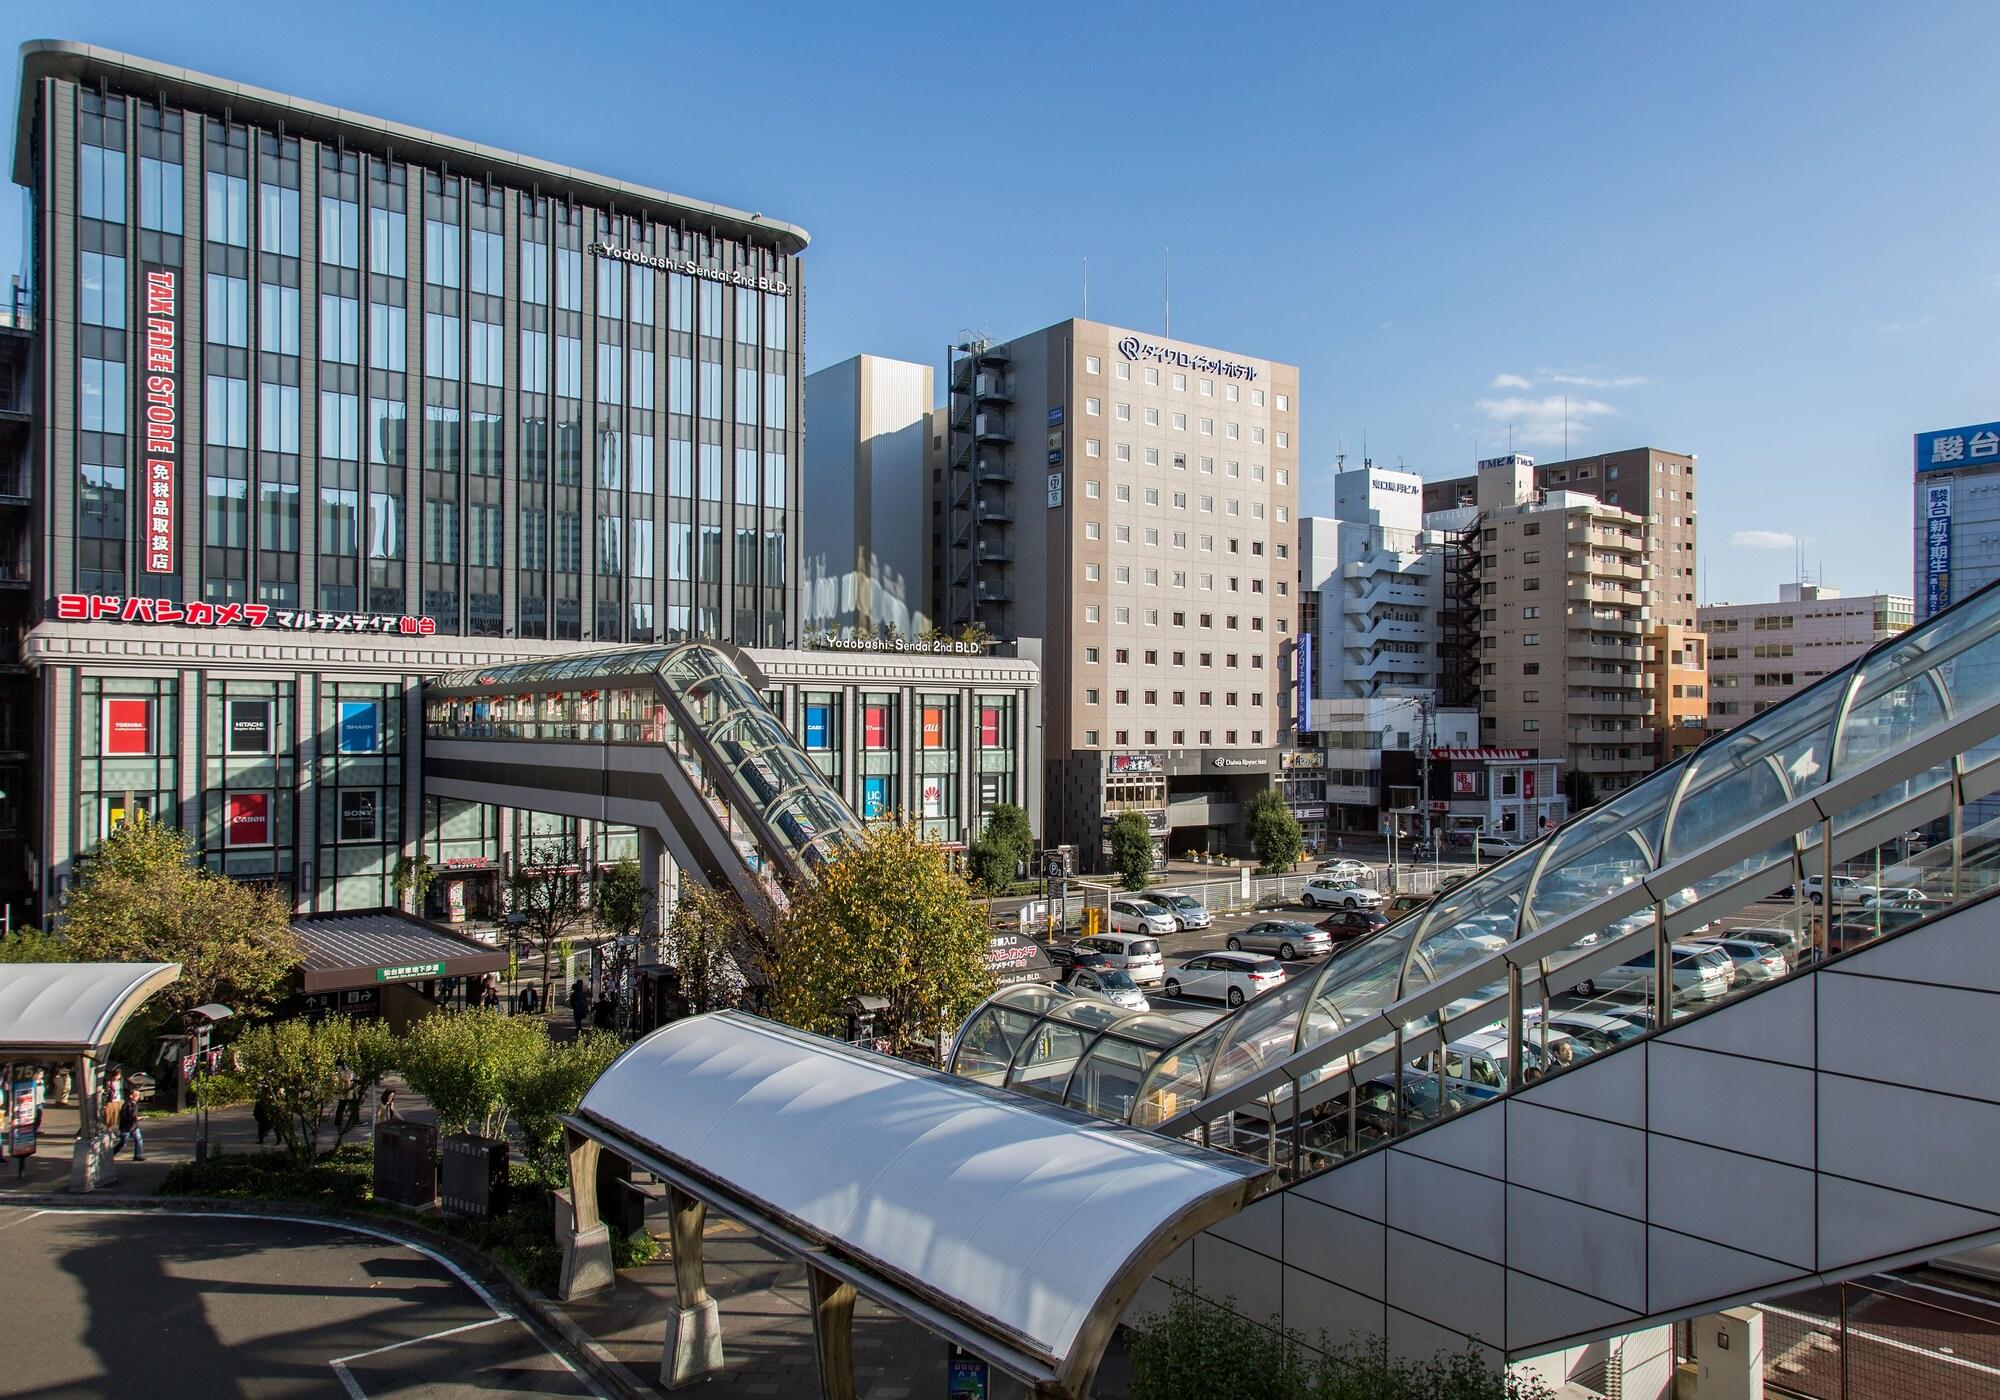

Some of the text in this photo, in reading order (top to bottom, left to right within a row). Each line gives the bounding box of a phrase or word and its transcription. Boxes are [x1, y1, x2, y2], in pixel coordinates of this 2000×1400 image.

[603, 241, 730, 281] Yodobashi-Sendai
[733, 270, 755, 287] 2nd
[147, 271, 175, 454] TAX FREE STORE
[1141, 344, 1258, 381] ダイワロイネットホテル
[1477, 455, 1515, 470] TMビル
[1931, 431, 2000, 463] 駿台
[151, 463, 170, 571] 免税品取扱店
[58, 594, 437, 635] ヨドバシカメラ マルチメディア 仙台
[826, 635, 931, 652] Yodobashi-Sendai
[933, 640, 952, 653] 2nd
[923, 723, 939, 732] au
[232, 815, 266, 824] Canon
[15, 1065, 33, 1078] 75
